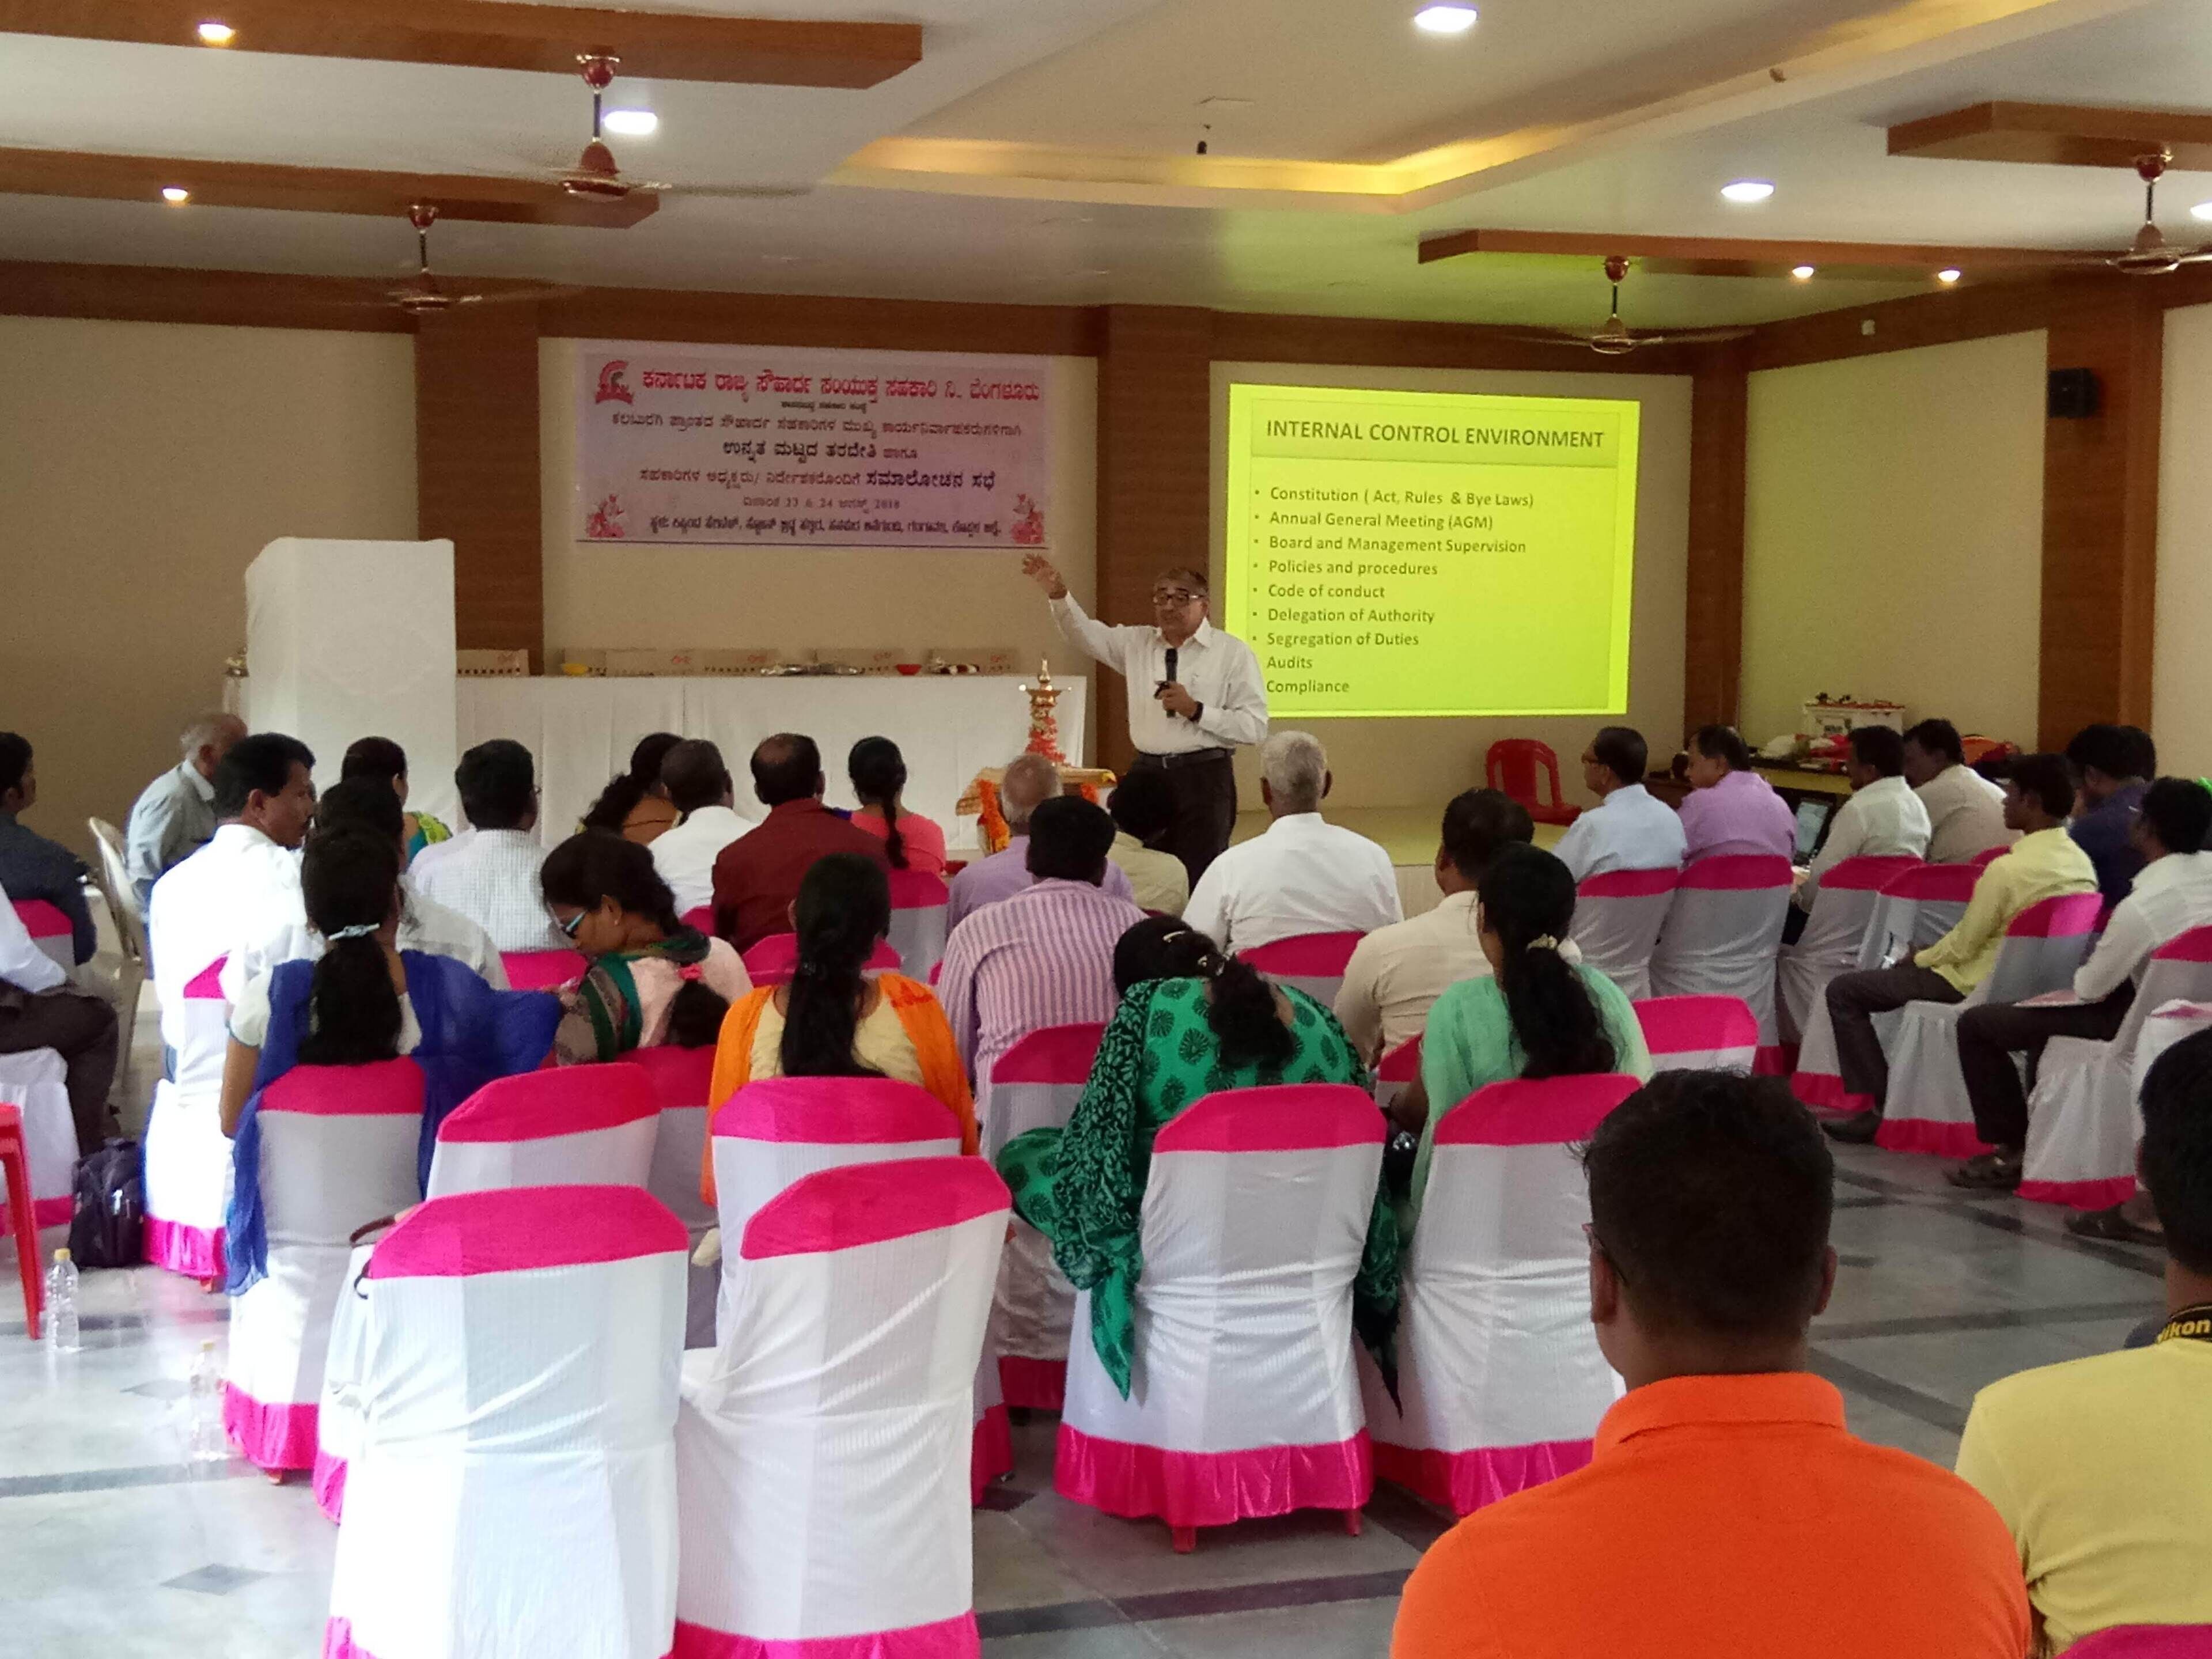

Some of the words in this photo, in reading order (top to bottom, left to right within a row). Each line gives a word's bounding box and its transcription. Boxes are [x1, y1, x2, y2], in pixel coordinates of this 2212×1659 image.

[643, 370, 706, 390] ಕರ್ನಾಟಕ
[715, 373, 749, 402] ರಾಜ್ಯ
[821, 374, 877, 403] ಸಂಯುಕ್ತ
[886, 378, 937, 397] ಸಹಕಾರಿ
[1267, 421, 1363, 440] INTERNAL
[1370, 425, 1459, 444] CONTROL
[1465, 428, 1603, 447] ENVIRONMENT
[723, 441, 766, 464] ಉನ್ನತ
[774, 442, 818, 463] ಮಟ್ಟದ
[826, 442, 876, 458] ತರಬೇತಿ
[972, 470, 996, 491] ಸಭೆ
[1271, 487, 1358, 501] Constitution
[1373, 490, 1400, 503] Act,
[1405, 491, 1442, 503] Rules
[1450, 492, 1461, 504] &
[1467, 493, 1491, 506] Bye
[1496, 494, 1533, 508] Laws)
[1270, 512, 1320, 525] Annual
[1325, 513, 1380, 526] General
[1386, 515, 1444, 530] Meeting
[1448, 516, 1493, 530] (AGM)
[1270, 536, 1312, 548] Board
[1317, 537, 1342, 549] and
[1349, 537, 1441, 553] Management
[1446, 539, 1526, 554] Supervision
[1269, 560, 1322, 573] Policies
[1327, 561, 1353, 573] and
[1358, 562, 1438, 576] procedures
[1268, 584, 1304, 597] Code
[1309, 584, 1323, 597] of
[1328, 586, 1385, 597] conduct
[1268, 608, 1344, 623] Delegation
[1350, 608, 1365, 621] of
[1368, 609, 1434, 624] Authority
[1267, 632, 1352, 648] Segregation
[1356, 632, 1371, 645] of
[1376, 633, 1419, 645] Duties
[1267, 656, 1312, 668] Audits
[1266, 680, 1349, 695] Compliance
